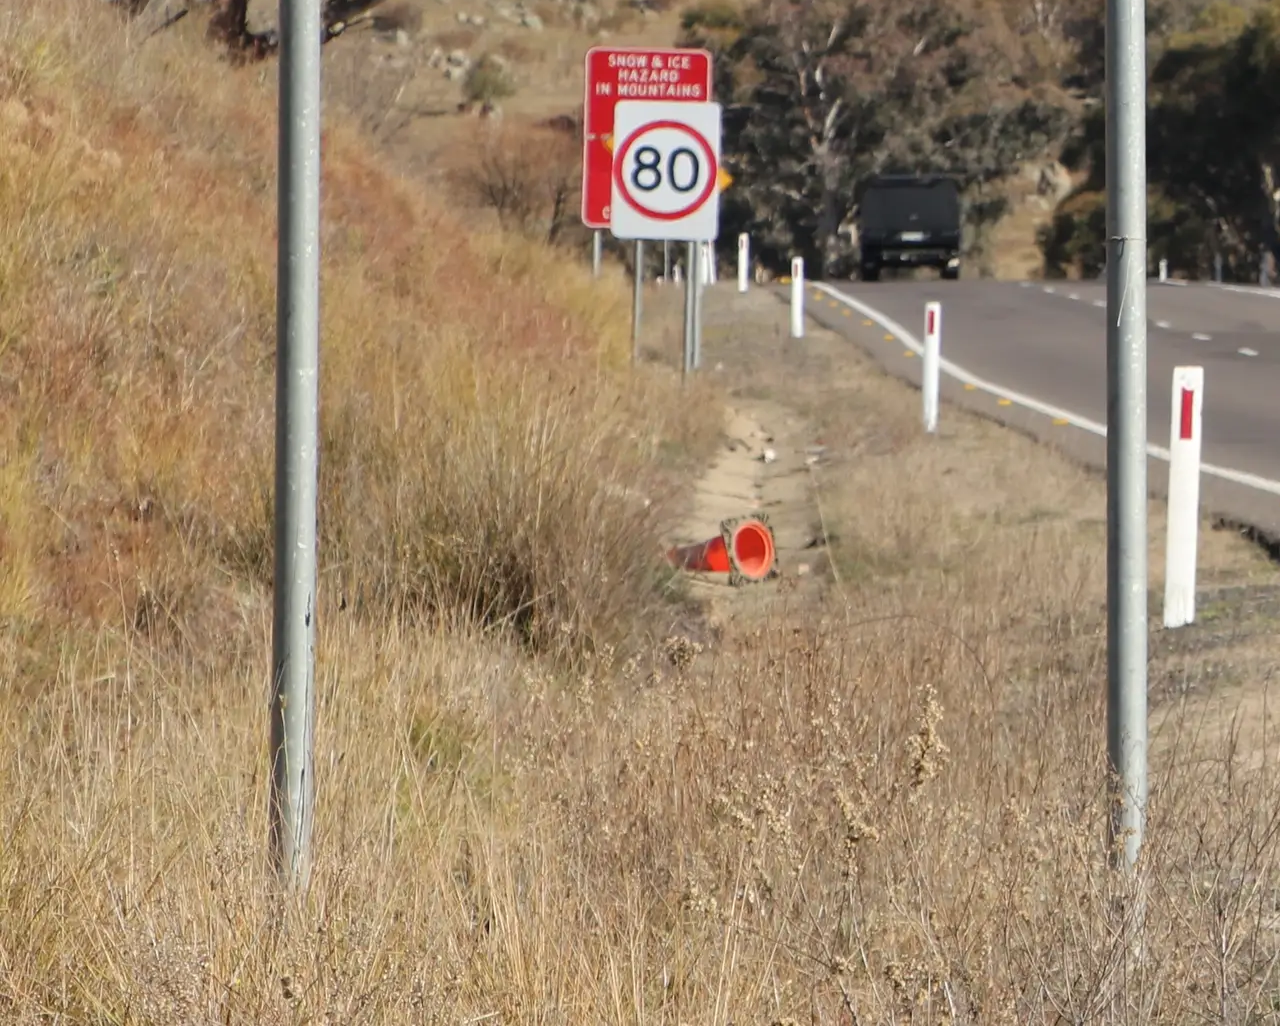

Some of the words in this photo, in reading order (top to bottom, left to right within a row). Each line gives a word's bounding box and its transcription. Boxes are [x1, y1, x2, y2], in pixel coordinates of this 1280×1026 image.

[608, 54, 648, 67] SNOW
[651, 55, 663, 68] &
[668, 56, 690, 69] ICE
[618, 69, 680, 82] HAZARD
[596, 82, 611, 95] IN
[617, 83, 701, 97] MOUNTAINS
[632, 146, 700, 192] 80
